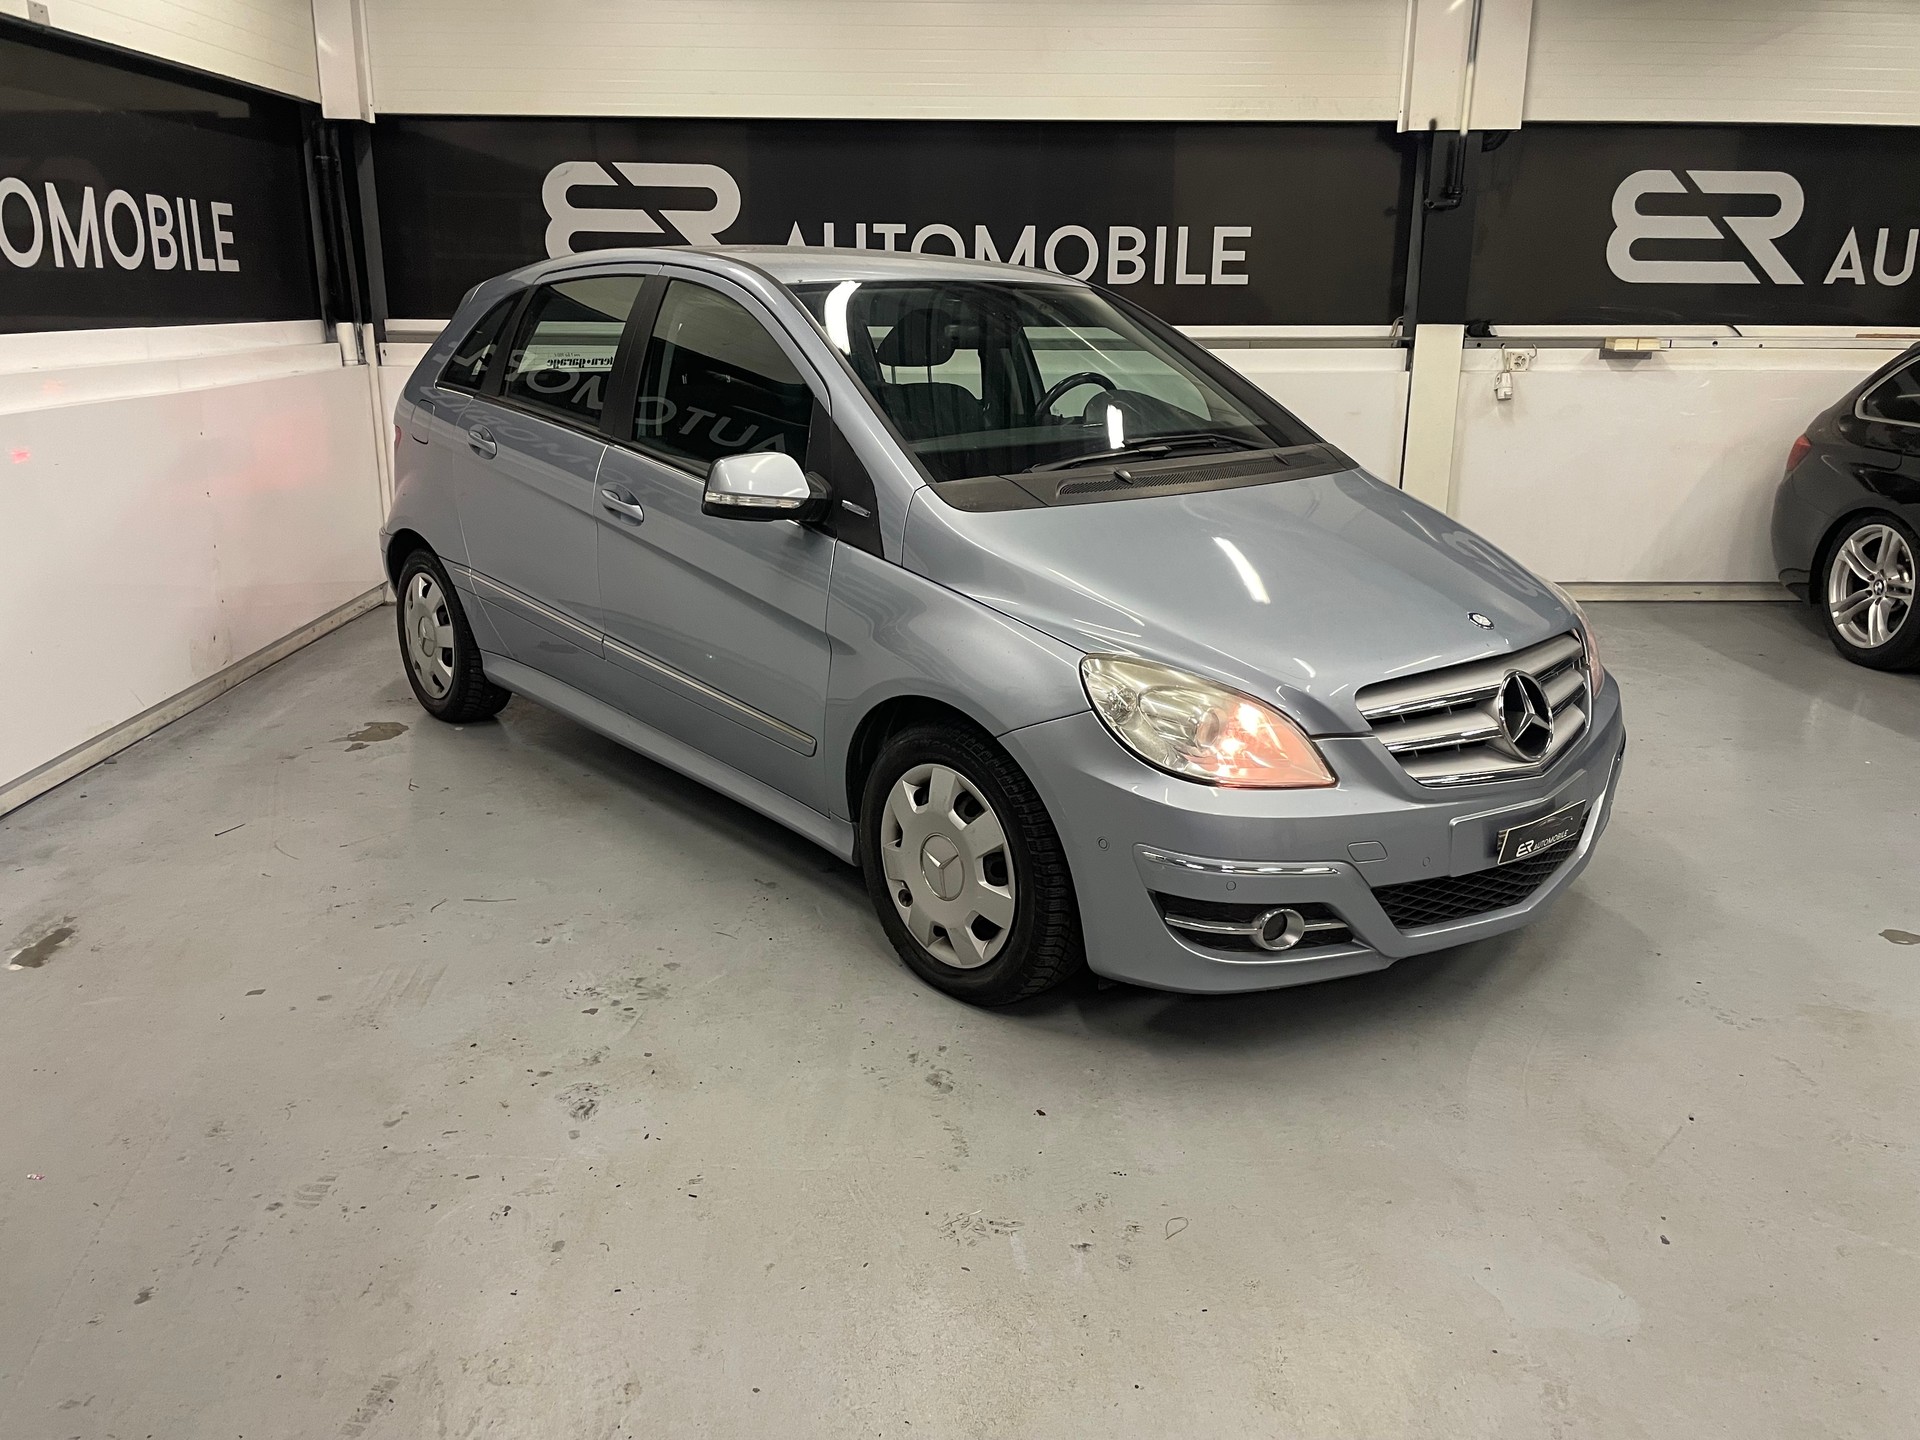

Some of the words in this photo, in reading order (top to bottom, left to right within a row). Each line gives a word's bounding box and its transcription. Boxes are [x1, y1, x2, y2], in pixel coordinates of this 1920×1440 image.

[0, 177, 240, 272] OMOBILE
[1822, 226, 1920, 286] AU
[1533, 829, 1569, 851] AUTOMOBILE
